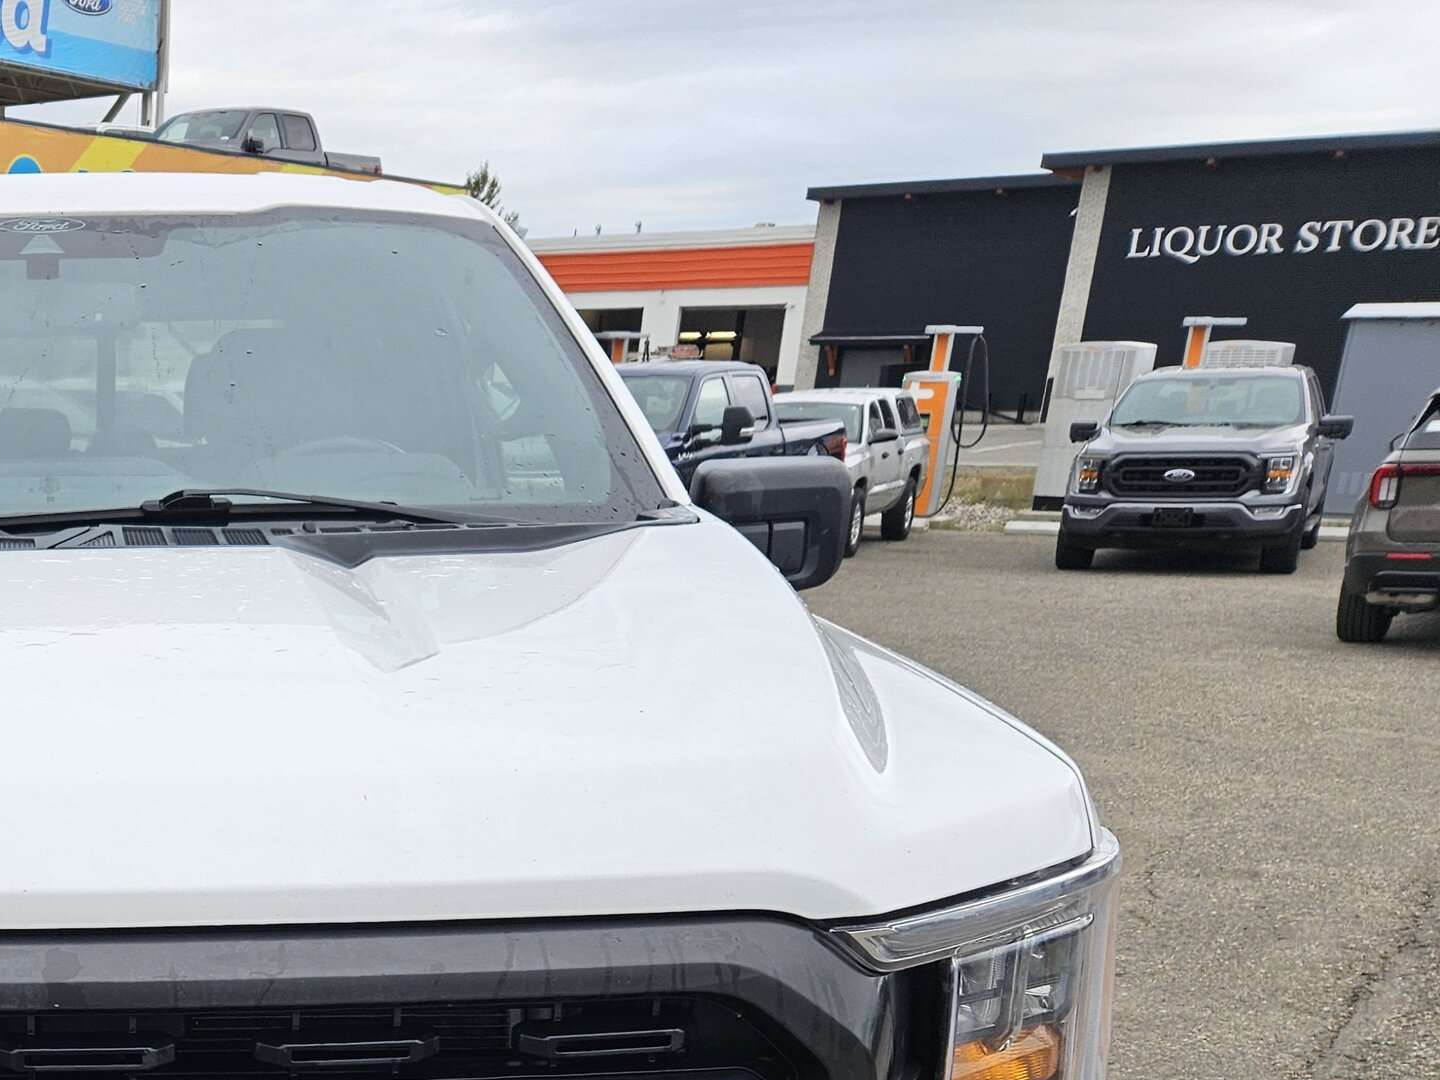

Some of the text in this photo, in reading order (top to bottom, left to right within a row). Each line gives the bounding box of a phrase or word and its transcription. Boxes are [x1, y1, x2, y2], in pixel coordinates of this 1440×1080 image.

[14, 219, 70, 231] Ford
[1125, 216, 1440, 264] LIQUOR STORE
